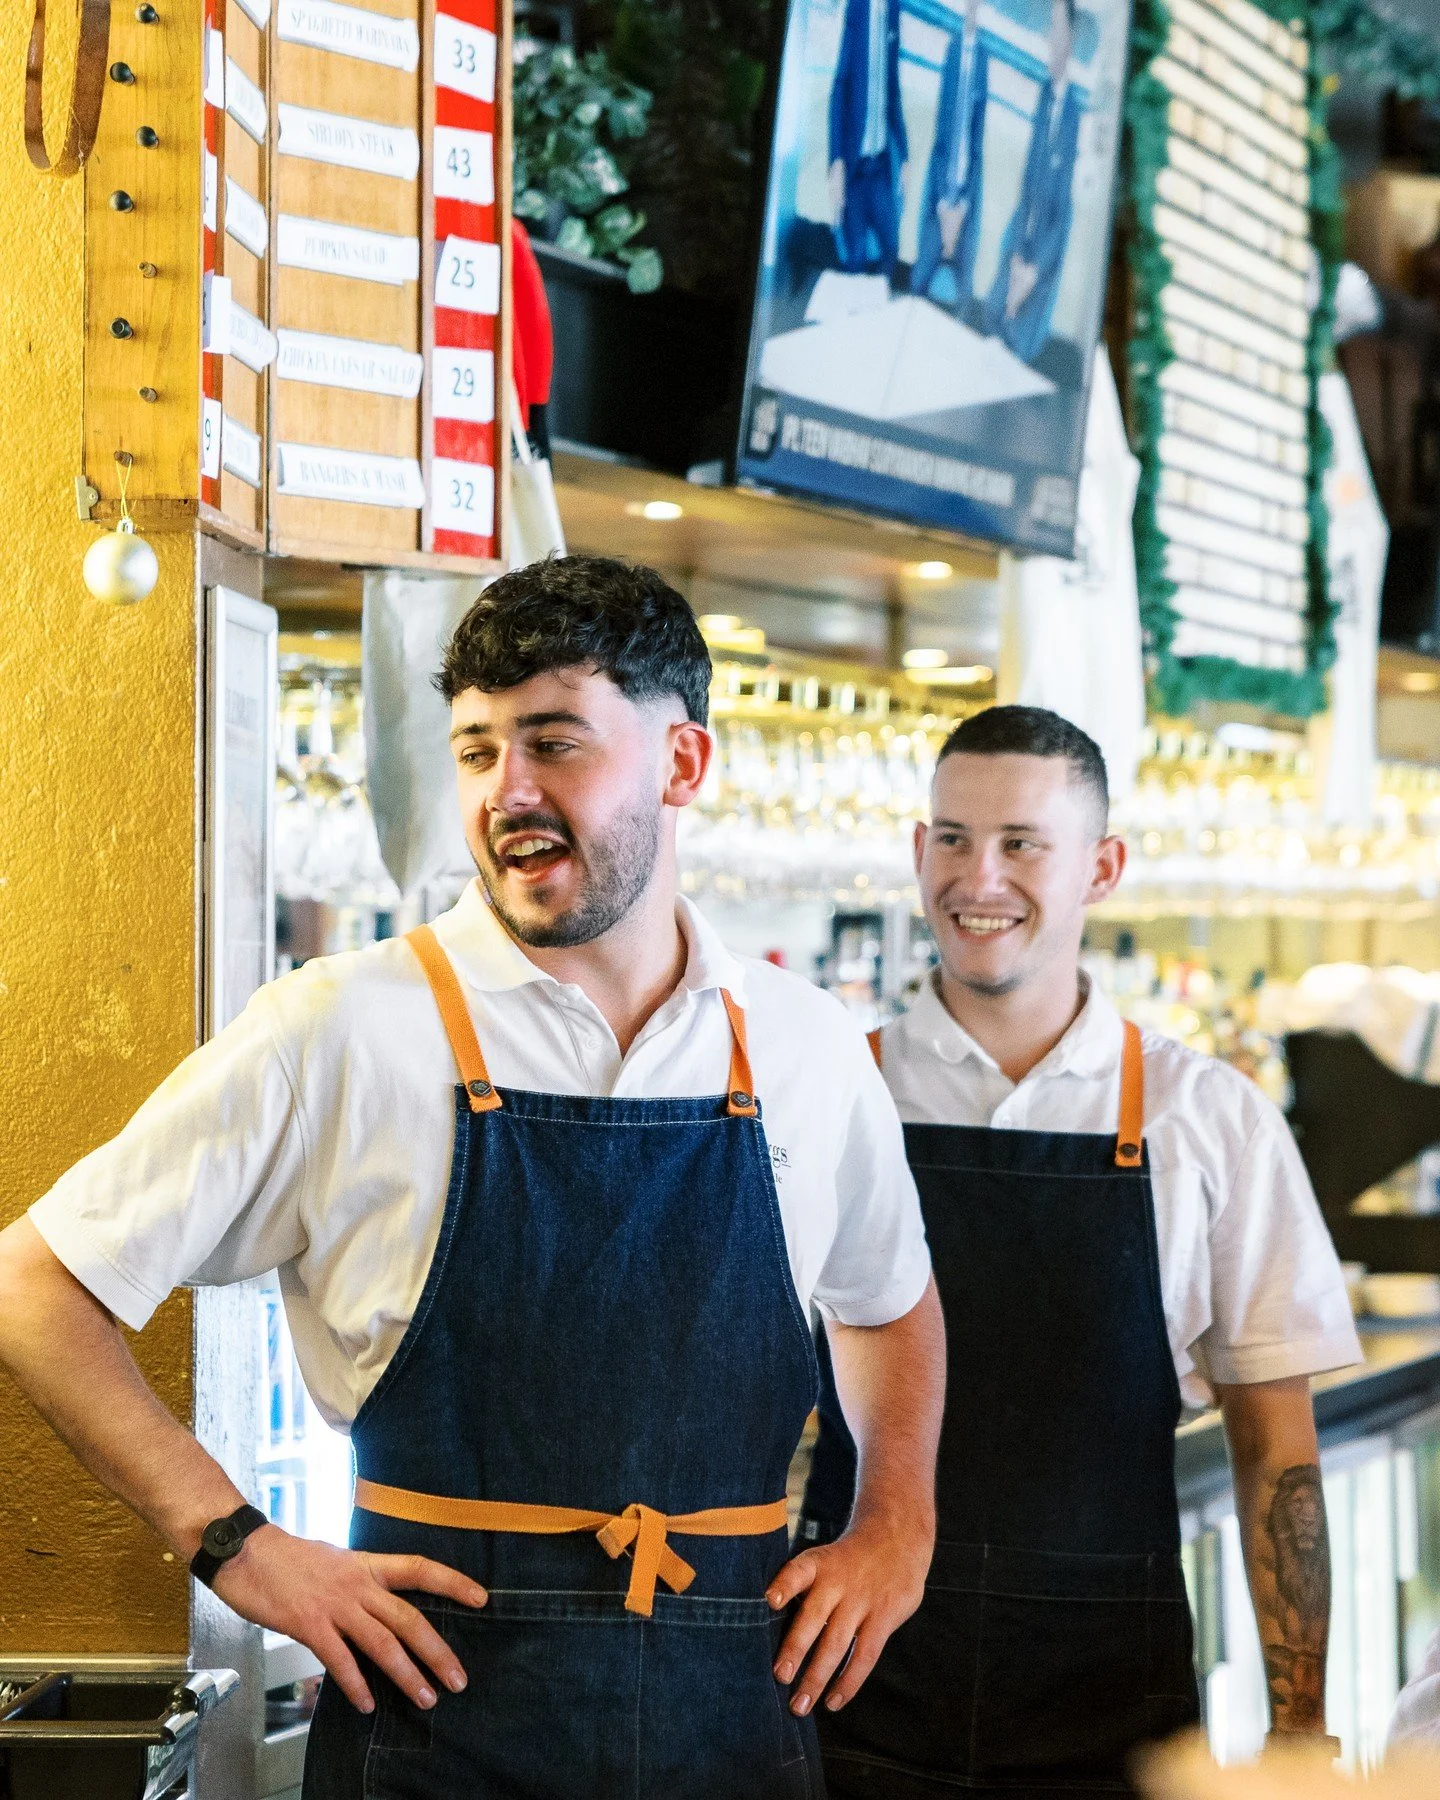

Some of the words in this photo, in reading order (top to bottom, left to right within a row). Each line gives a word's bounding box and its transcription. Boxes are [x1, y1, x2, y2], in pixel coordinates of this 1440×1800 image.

[291, 8, 352, 40] SPAGHETTI
[452, 38, 476, 73] 33
[306, 122, 355, 150] SIRLOIN
[359, 132, 394, 158] STEAK
[446, 147, 471, 178] 43
[354, 244, 387, 265] SALAD
[451, 257, 475, 288] 25
[282, 346, 329, 372] CHICKEN
[333, 353, 375, 380] CAESAR
[379, 364, 415, 385] SALAD
[452, 367, 474, 397] 29
[299, 460, 359, 486] BANGERS
[361, 468, 370, 488] &
[374, 469, 406, 491] MASH
[451, 479, 475, 511] 32
